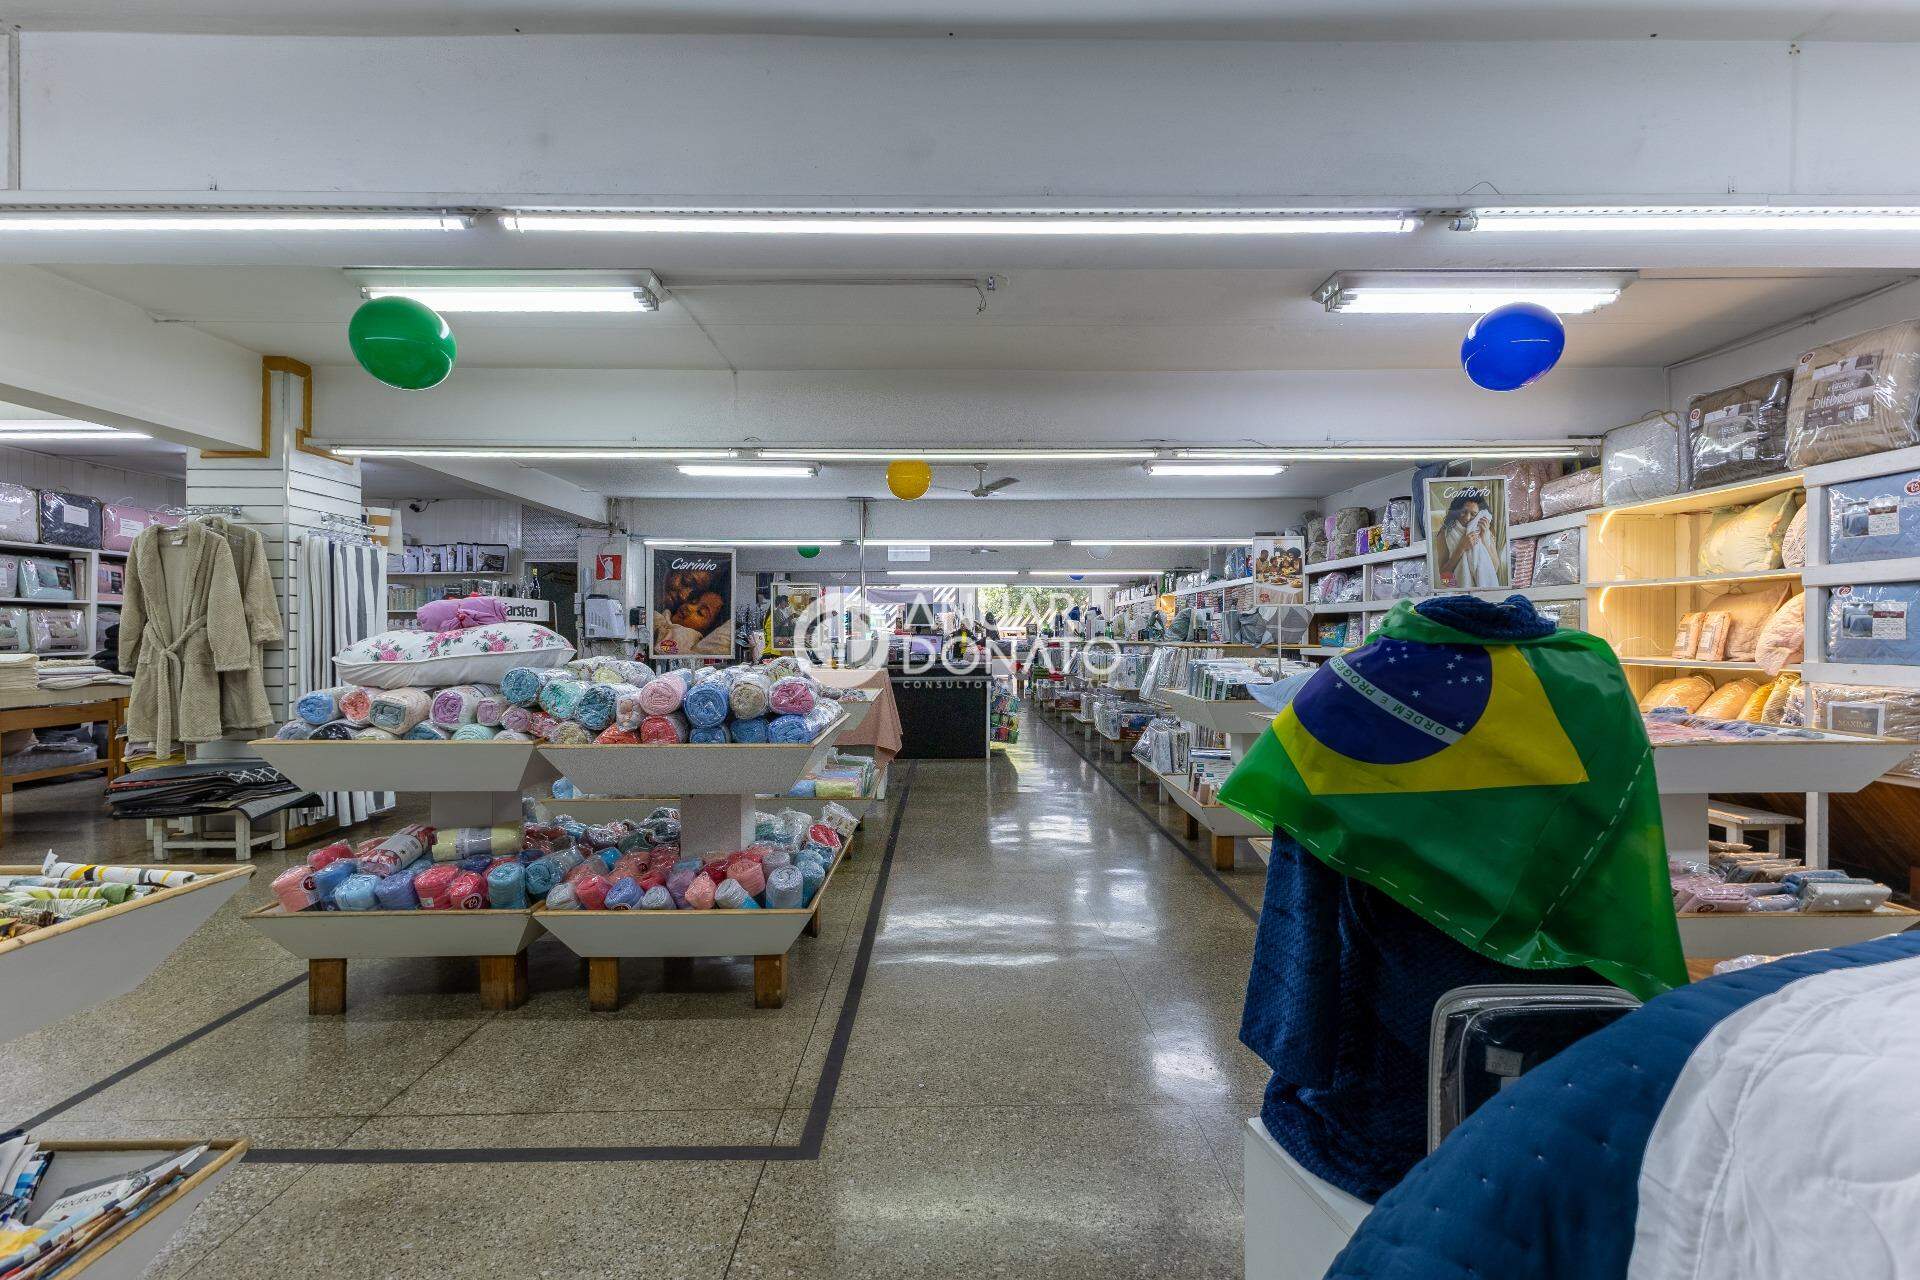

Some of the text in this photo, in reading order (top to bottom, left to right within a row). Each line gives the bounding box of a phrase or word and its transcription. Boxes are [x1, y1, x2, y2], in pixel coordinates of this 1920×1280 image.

[1443, 485, 1491, 499] Conforto
[671, 557, 718, 571] Carinho
[503, 602, 538, 618] arsten
[1332, 657, 1447, 736] ORDEM E PROGRE
